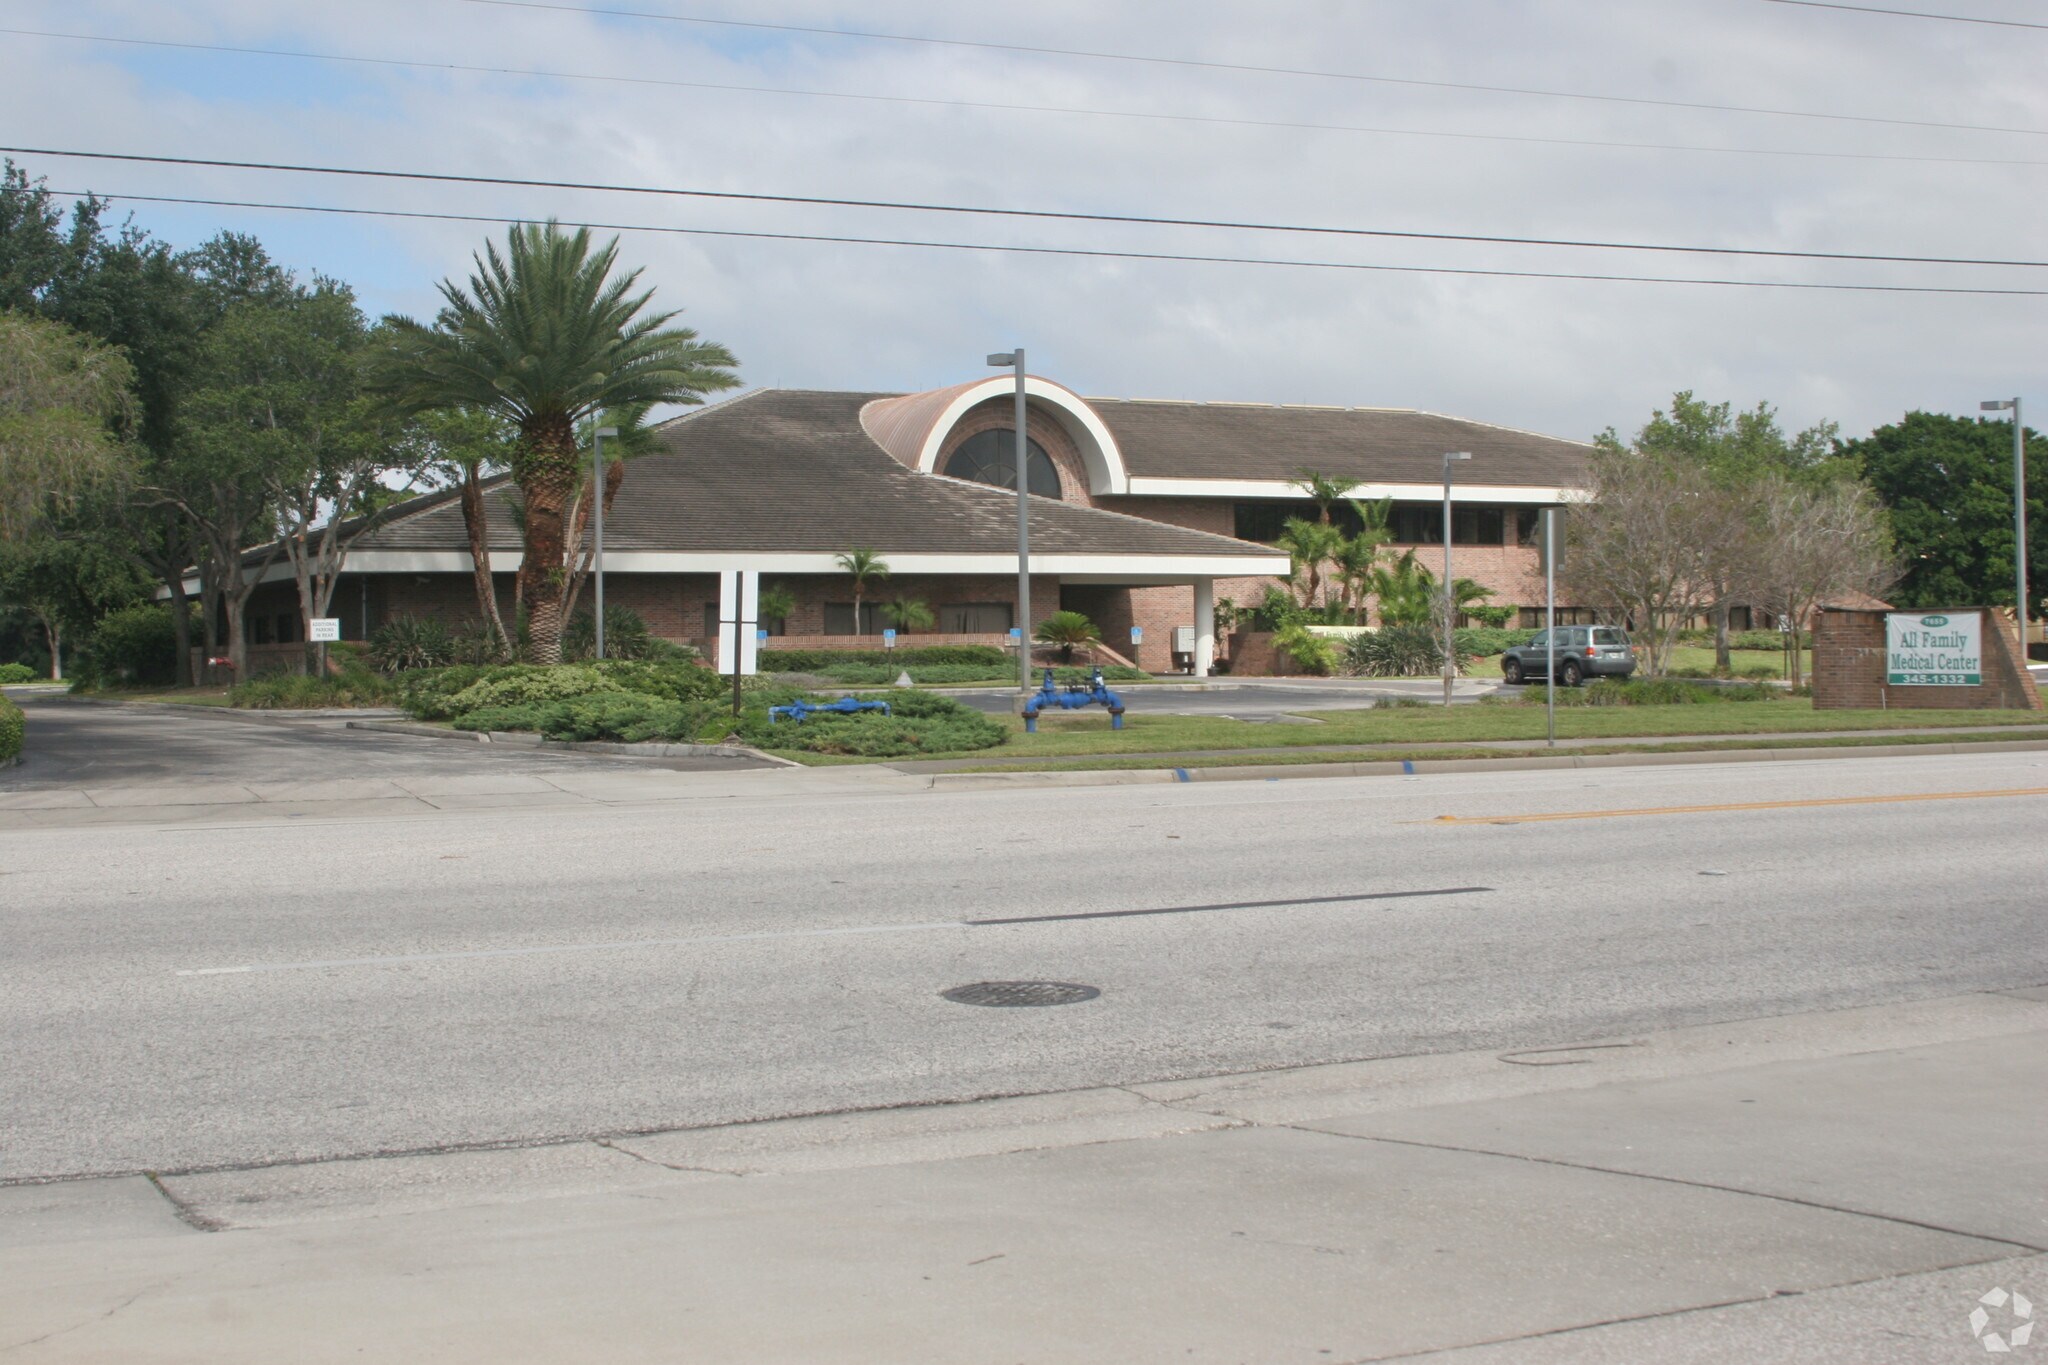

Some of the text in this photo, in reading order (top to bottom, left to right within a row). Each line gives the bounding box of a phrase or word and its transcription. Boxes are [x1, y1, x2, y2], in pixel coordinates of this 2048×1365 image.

[1901, 630, 1967, 652] All Family
[1891, 653, 1978, 670] Medical Center
[1903, 675, 1965, 683] 345-1332
